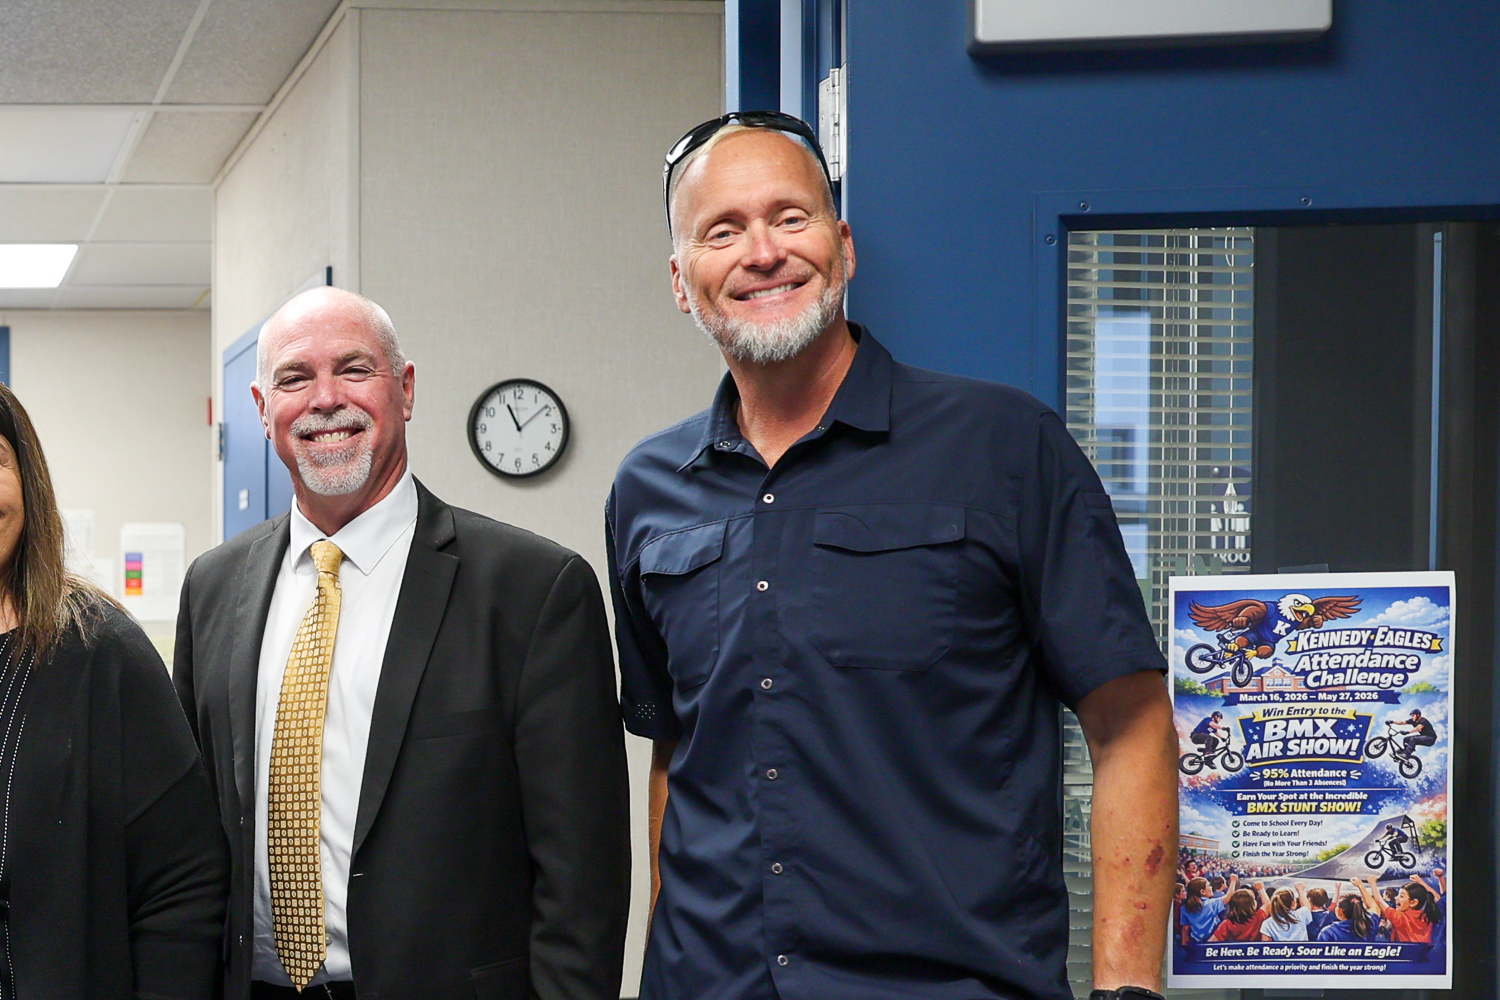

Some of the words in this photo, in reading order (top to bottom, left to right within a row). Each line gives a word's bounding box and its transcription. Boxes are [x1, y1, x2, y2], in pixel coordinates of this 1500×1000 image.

[499, 394, 505, 404] 11
[514, 389, 524, 400] 12
[485, 407, 496, 418] 10
[545, 406, 552, 417] 2
[480, 423, 487, 434] 9
[551, 424, 557, 434] 3
[485, 440, 492, 451] 8
[544, 441, 551, 451] 4
[499, 453, 504, 463] 7
[514, 458, 521, 468] 6
[532, 453, 538, 464] 5
[1273, 620, 1290, 635] K
[1297, 629, 1371, 651] KENNEDY
[1374, 626, 1433, 649] EAGLES
[1295, 649, 1419, 672] Attendance
[1307, 668, 1405, 688] Challenge
[1239, 693, 1267, 702] March
[1270, 693, 1283, 702] 16,
[1285, 692, 1308, 701] 2026
[1318, 692, 1337, 702] May
[1339, 692, 1353, 702] 27,
[1355, 692, 1379, 700] 2026
[1262, 708, 1284, 717] Win
[1286, 707, 1317, 717] Entry
[1318, 706, 1329, 715] to
[1331, 707, 1347, 715] the
[1263, 718, 1338, 741] BMX
[1246, 740, 1284, 761] AIR
[1286, 739, 1361, 756] SHOW!
[1262, 768, 1290, 779] 95%
[1291, 768, 1348, 778] Attendance
[1314, 779, 1347, 787] Absences!)
[1236, 793, 1257, 801] Earn
[1278, 792, 1298, 801] Spot
[1309, 792, 1324, 800] the
[1325, 792, 1369, 800] Incredible
[1247, 802, 1279, 813] BMX
[1280, 802, 1318, 813] STUNT
[1319, 801, 1362, 813] SHOW!
[1290, 820, 1308, 828] Every
[1251, 830, 1271, 838] Ready
[1286, 850, 1309, 858] Strong!
[1205, 947, 1219, 957] Be
[1220, 947, 1245, 957] Here.
[1246, 946, 1260, 956] Be
[1262, 945, 1295, 958] Ready.
[1296, 946, 1323, 956] Soar
[1324, 946, 1346, 956] Like
[1347, 948, 1363, 956] an
[1364, 945, 1402, 959] Eagle!
[1284, 964, 1308, 972] priority
[1363, 964, 1387, 972] strong!
